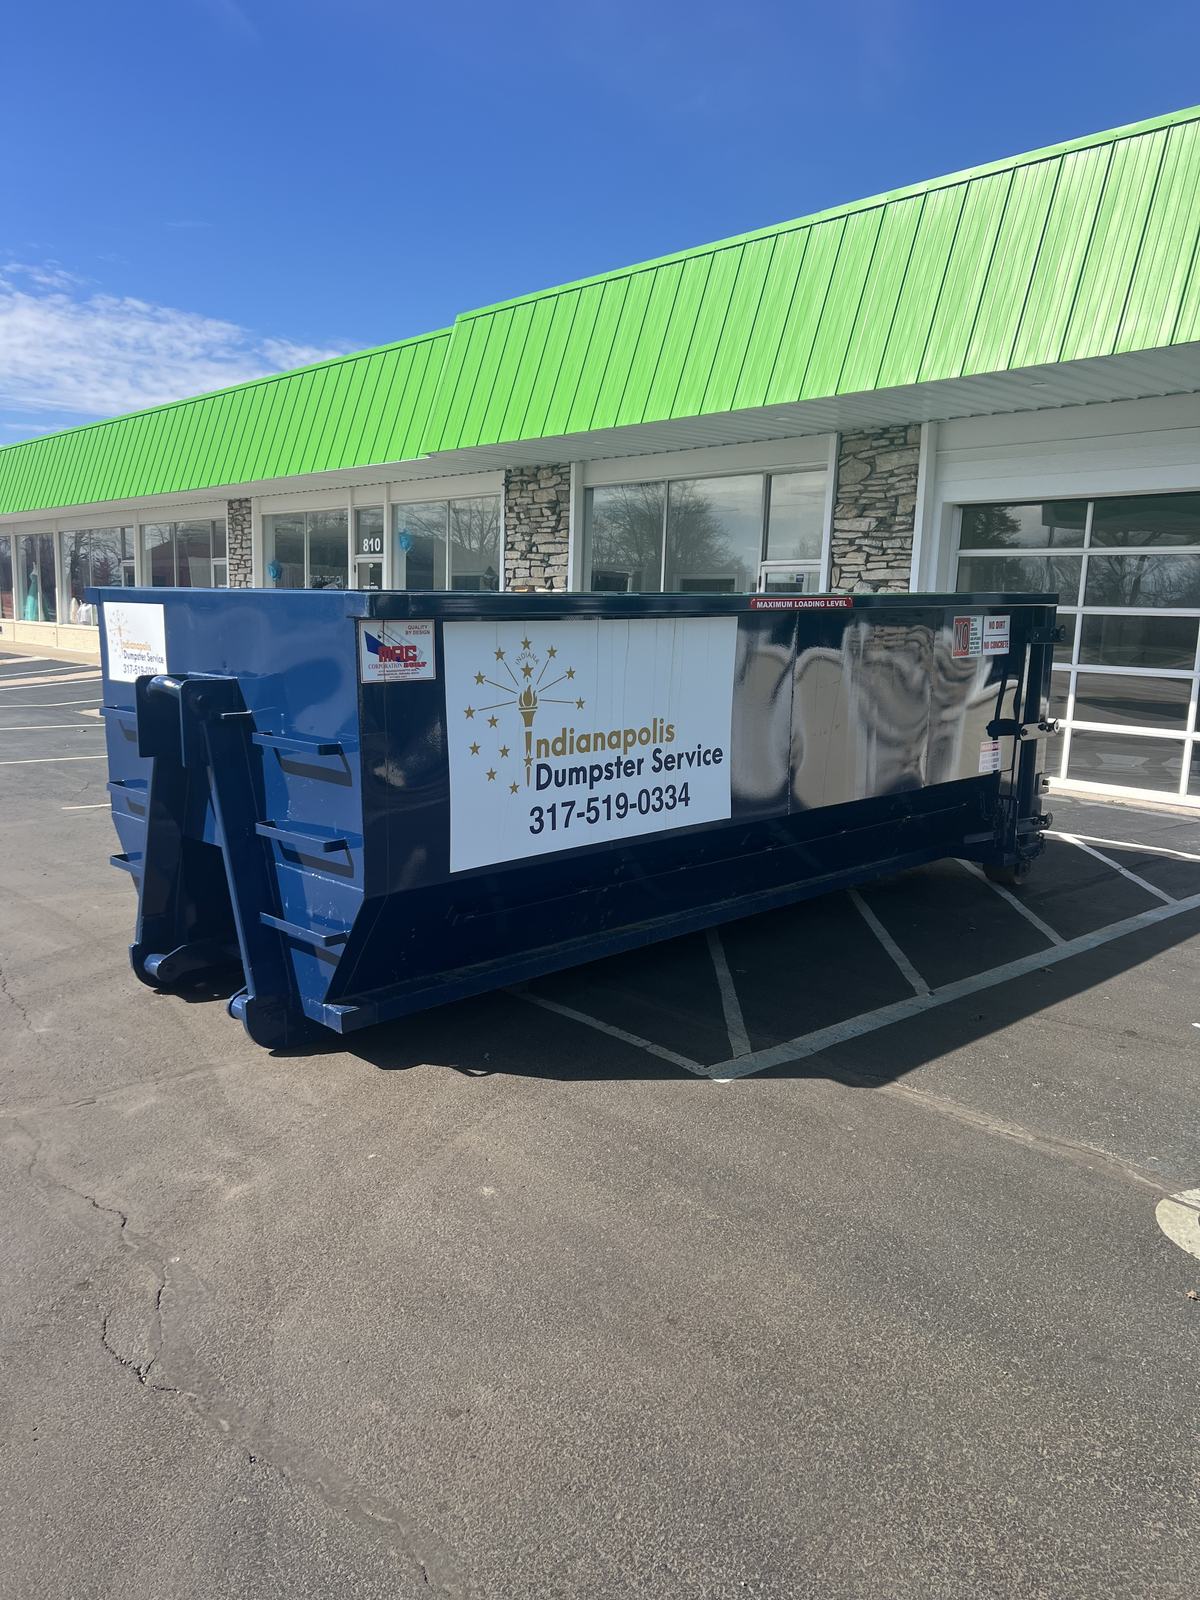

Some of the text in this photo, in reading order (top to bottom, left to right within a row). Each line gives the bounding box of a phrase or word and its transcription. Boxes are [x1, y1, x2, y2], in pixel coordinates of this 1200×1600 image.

[363, 538, 380, 551] 810
[795, 600, 825, 608] LOADING
[953, 621, 969, 651] NO
[514, 651, 540, 665] INDIANA
[536, 744, 723, 791] Dumpster Service
[529, 782, 691, 835] 317-519-0334
